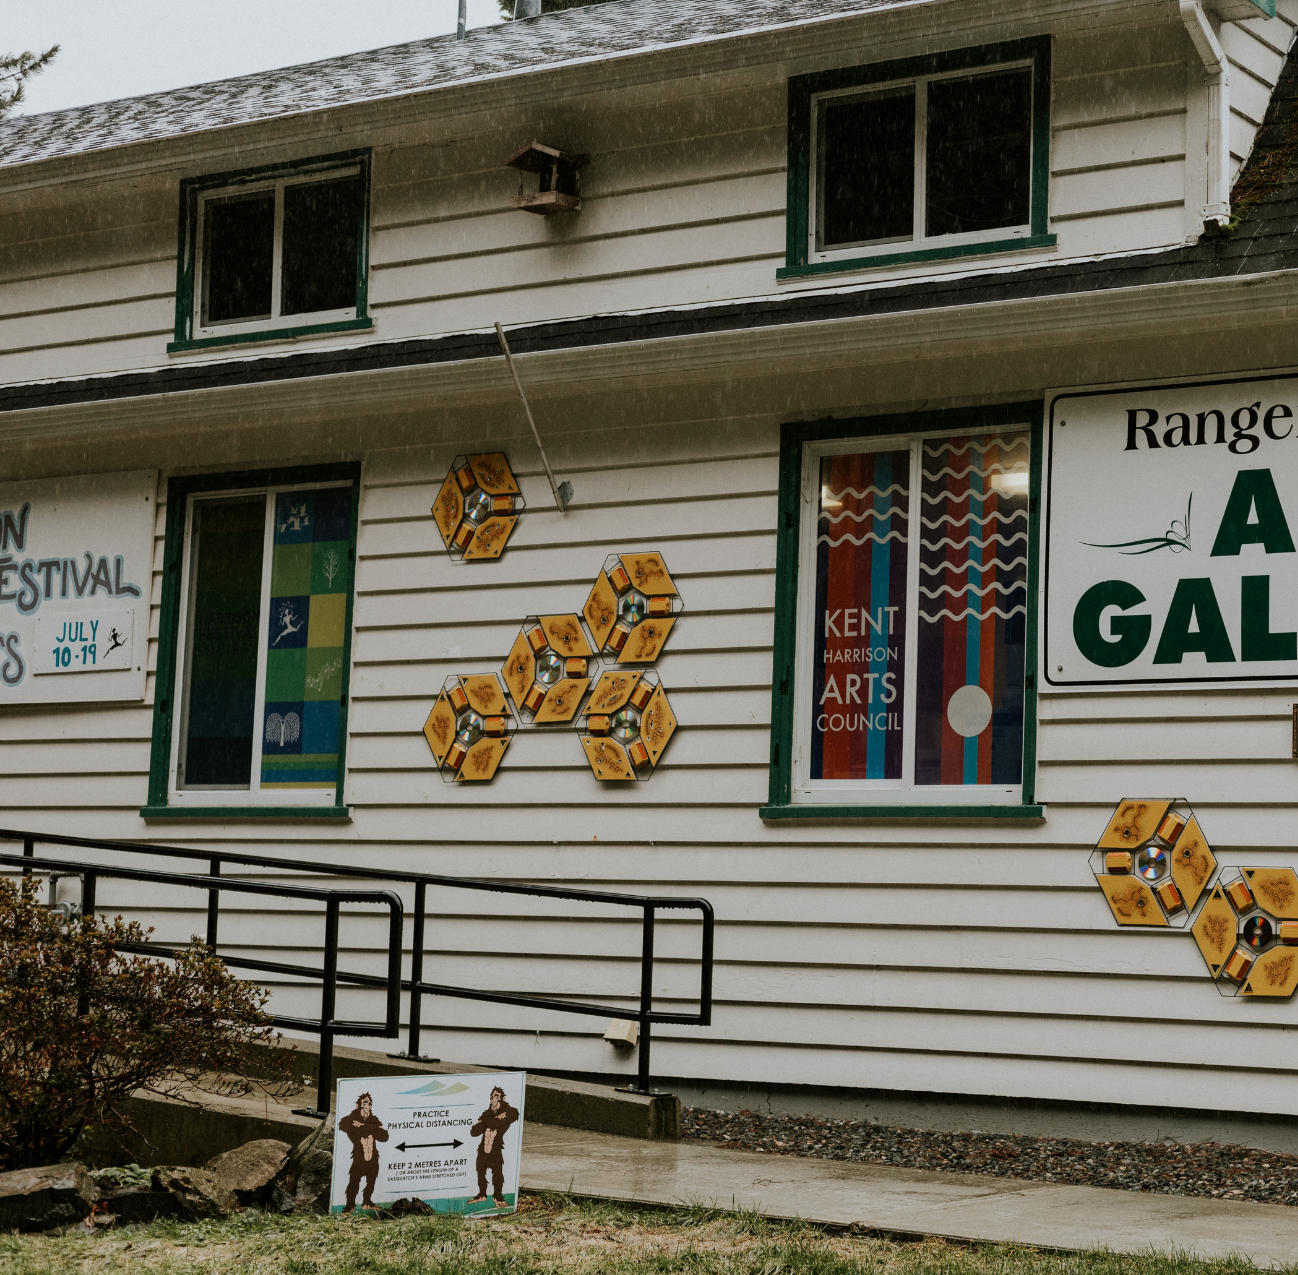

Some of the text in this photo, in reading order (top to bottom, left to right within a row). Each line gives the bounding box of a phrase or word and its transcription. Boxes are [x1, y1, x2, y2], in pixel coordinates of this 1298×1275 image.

[0, 502, 31, 554] N
[55, 620, 99, 643] JULY
[824, 606, 899, 638] KENT
[823, 646, 898, 663] HARRISON
[819, 671, 897, 705] ARTS
[816, 712, 901, 732] COUNCIL
[387, 1118, 473, 1130] PHYSICAL DISTANCING
[412, 1110, 450, 1118] PRACTICE
[388, 1162, 406, 1170] KEEP
[414, 1160, 441, 1169] METRES
[443, 1158, 467, 1167] APART
